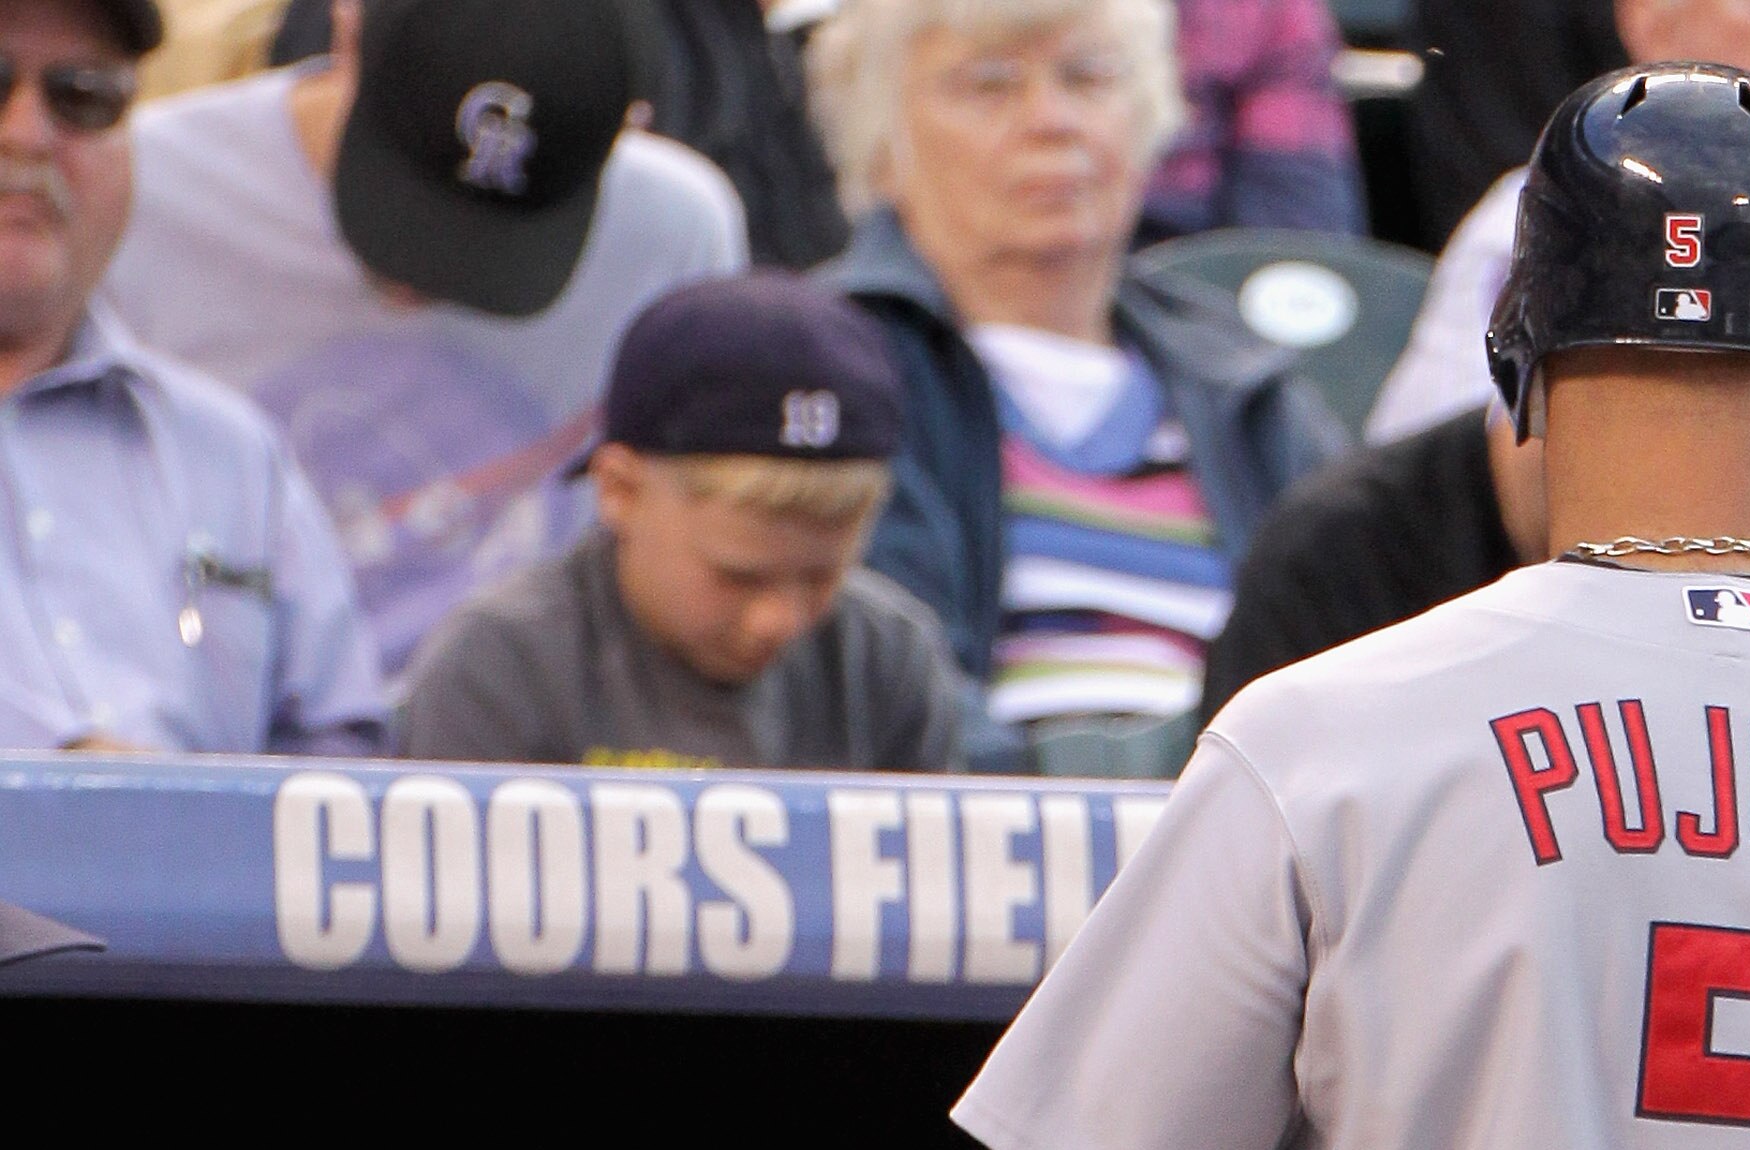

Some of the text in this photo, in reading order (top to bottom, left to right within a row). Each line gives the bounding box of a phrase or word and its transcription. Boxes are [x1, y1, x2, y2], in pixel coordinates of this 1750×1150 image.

[1664, 216, 1701, 268] 5
[274, 771, 1168, 984] COORS FIEL
